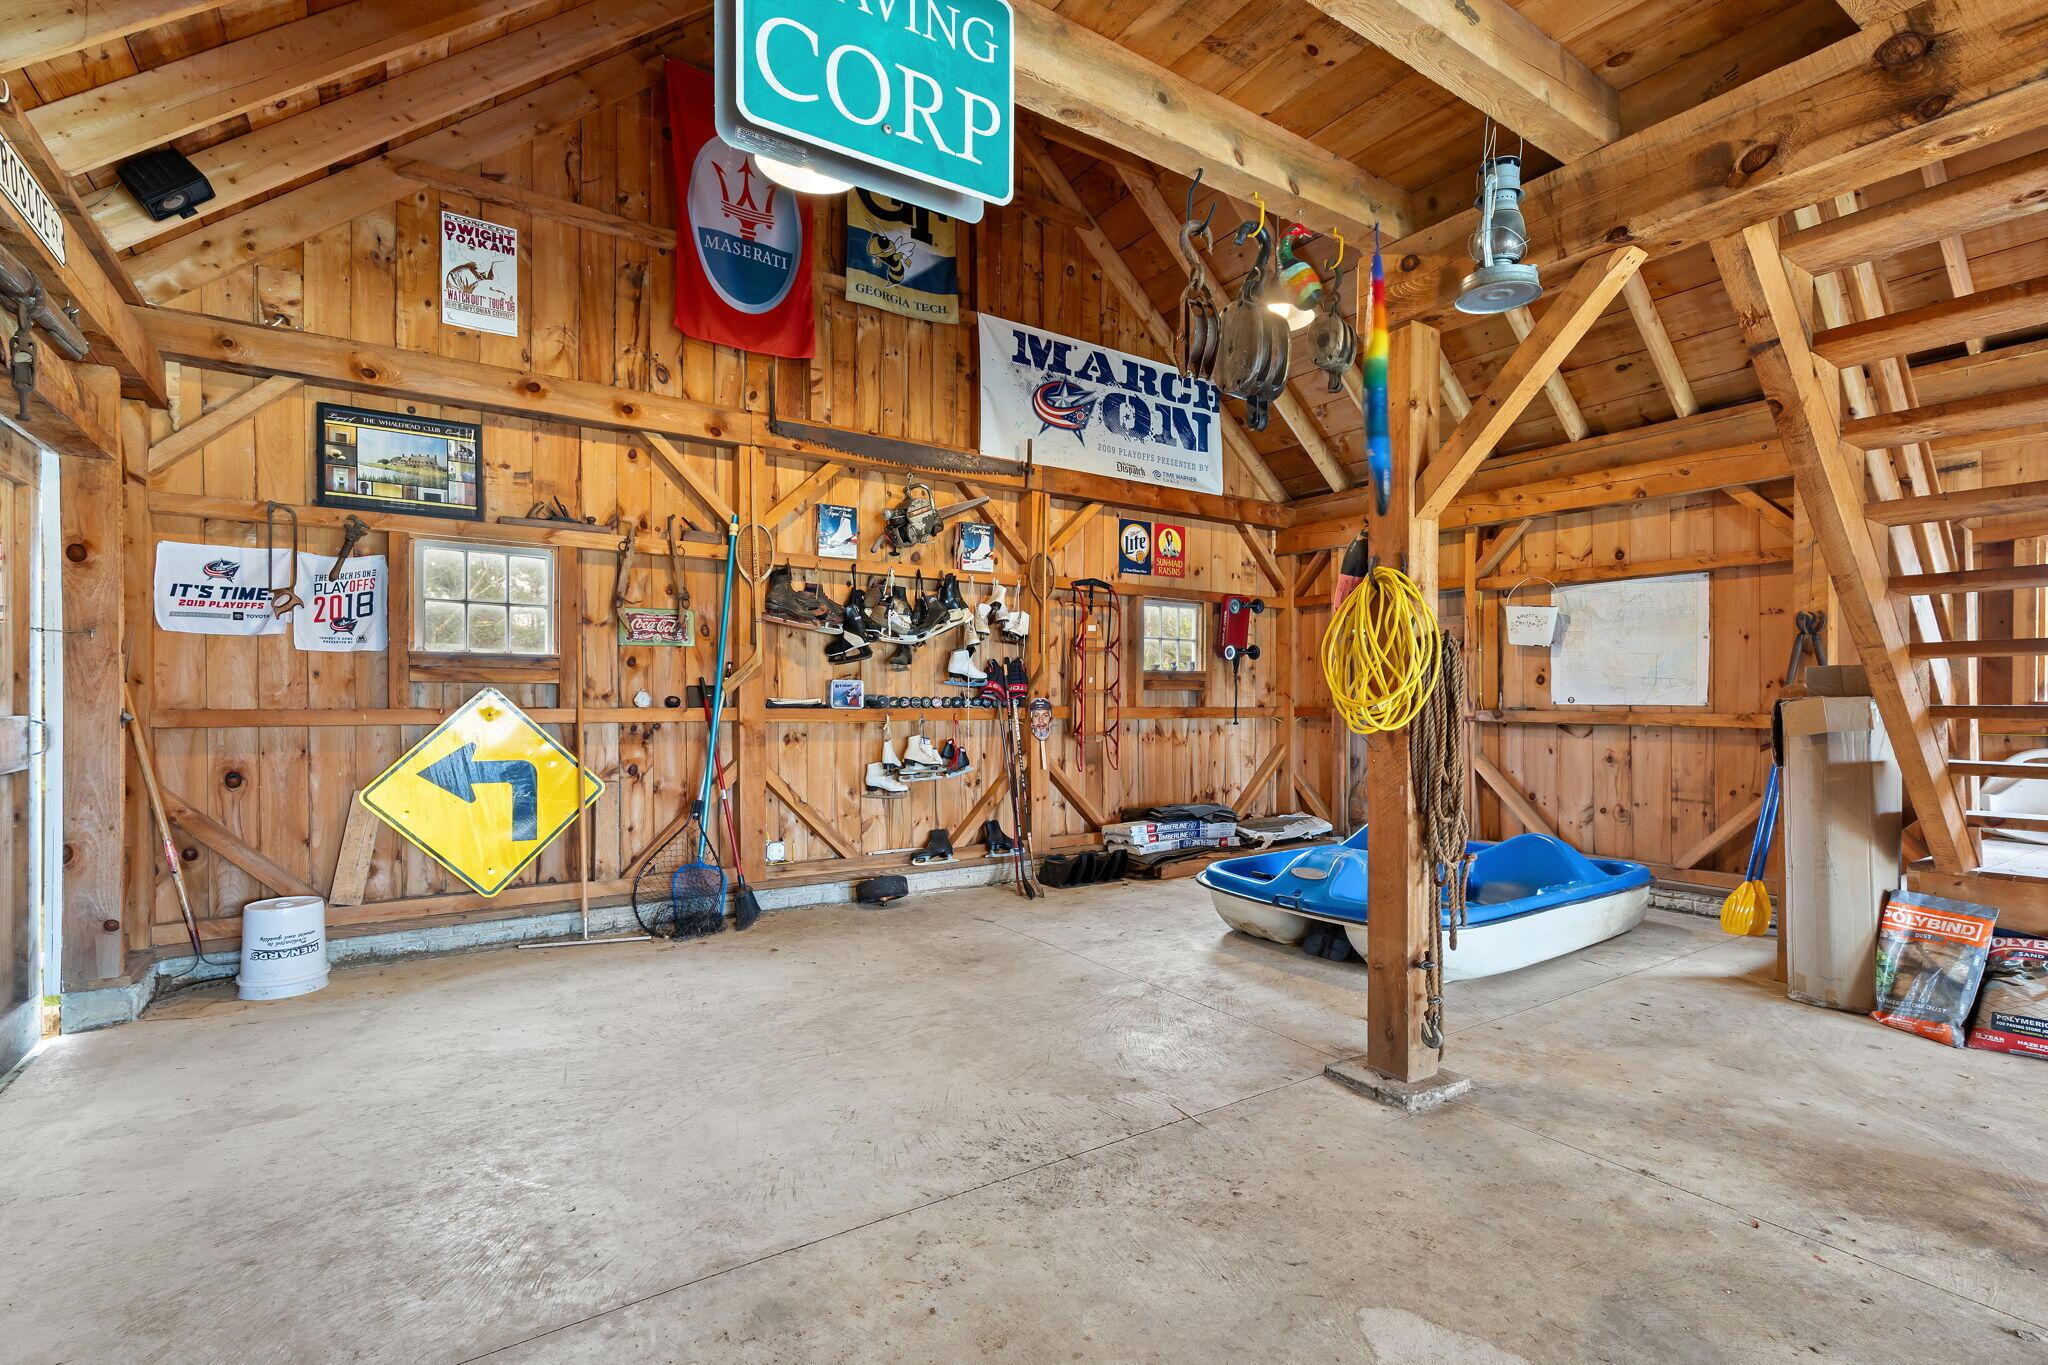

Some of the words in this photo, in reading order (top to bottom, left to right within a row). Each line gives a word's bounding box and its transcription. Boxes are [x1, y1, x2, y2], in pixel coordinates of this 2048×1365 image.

[755, 17, 1001, 165] CORP
[0, 141, 50, 239] ROSCOE
[444, 220, 515, 246] DWIGHT
[445, 231, 516, 256] YOAKAM
[704, 234, 788, 270] MASERATI
[489, 297, 505, 310] TOUR
[855, 282, 910, 309] GEORGIA
[914, 302, 948, 315] TECH
[1012, 330, 1221, 414] MARCH
[378, 420, 421, 430] WHALEHEAD
[423, 425, 441, 433] CLUB
[1101, 392, 1212, 453] ON
[1097, 443, 1116, 455] 2009
[1118, 448, 1155, 463] PLAYOFFS
[1157, 456, 1197, 471] PRESENTED
[1199, 464, 1209, 472] BY
[1116, 461, 1146, 477] Dispatch
[1162, 471, 1175, 480] TIME
[1177, 474, 1197, 483] WARNER
[1125, 534, 1146, 555] Lite
[1156, 558, 1183, 568] SUN-MAID
[1158, 567, 1181, 576] RAISINS
[314, 574, 328, 582] THE
[355, 571, 361, 579] IS
[362, 570, 372, 578] ON
[170, 583, 214, 599] IT'S
[220, 586, 272, 601] TIME.
[314, 578, 376, 595] PLAYOFFS
[178, 599, 206, 607] 2019
[208, 600, 265, 609] PLAYOFFS
[313, 591, 374, 623] 2018
[631, 618, 677, 633] Coca-Col
[1156, 821, 1189, 831] TIMBERLINE
[1158, 831, 1189, 841] TIMBERLINE
[1884, 908, 1976, 936] POLYBIND
[1915, 932, 1932, 940] DUST
[1992, 937, 2048, 949] OLYB
[250, 942, 319, 961] MENARDS
[1876, 996, 1904, 1008] LYMERIC
[1925, 1004, 1947, 1014] DUST
[2006, 1022, 2025, 1030] PAVING
[2017, 1040, 2039, 1048] HAZE
